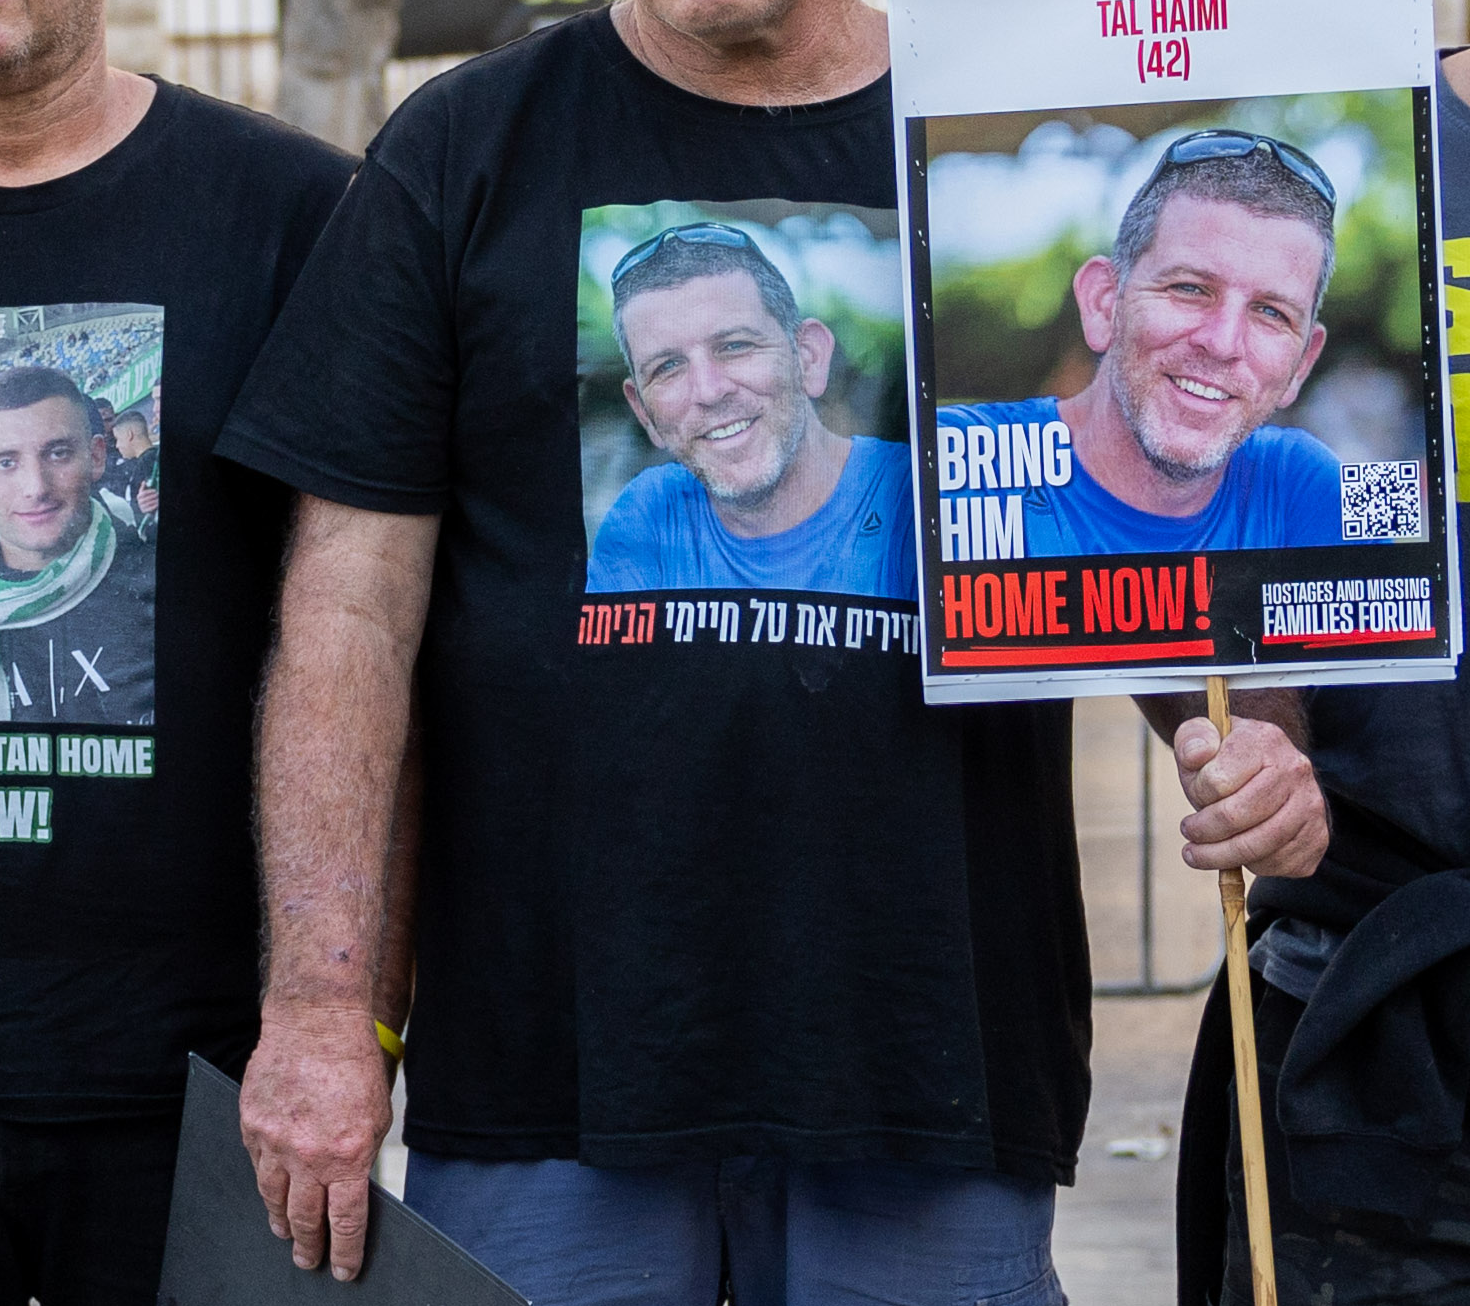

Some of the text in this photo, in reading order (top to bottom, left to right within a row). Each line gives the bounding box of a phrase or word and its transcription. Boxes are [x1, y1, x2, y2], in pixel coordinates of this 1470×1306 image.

[1136, 37, 1191, 83] (42)
[937, 420, 1072, 490] BRING
[939, 496, 1025, 562] HIM
[943, 556, 1214, 640] HOME NOW!
[1263, 578, 1430, 605] HOSTAGES AND MISSING
[578, 602, 656, 645] הביתה
[666, 601, 739, 643] חיימי
[750, 598, 786, 644] טל
[794, 603, 836, 647] את
[1264, 600, 1432, 637] FAMILIES FORUM
[60, 737, 153, 775] HOME
